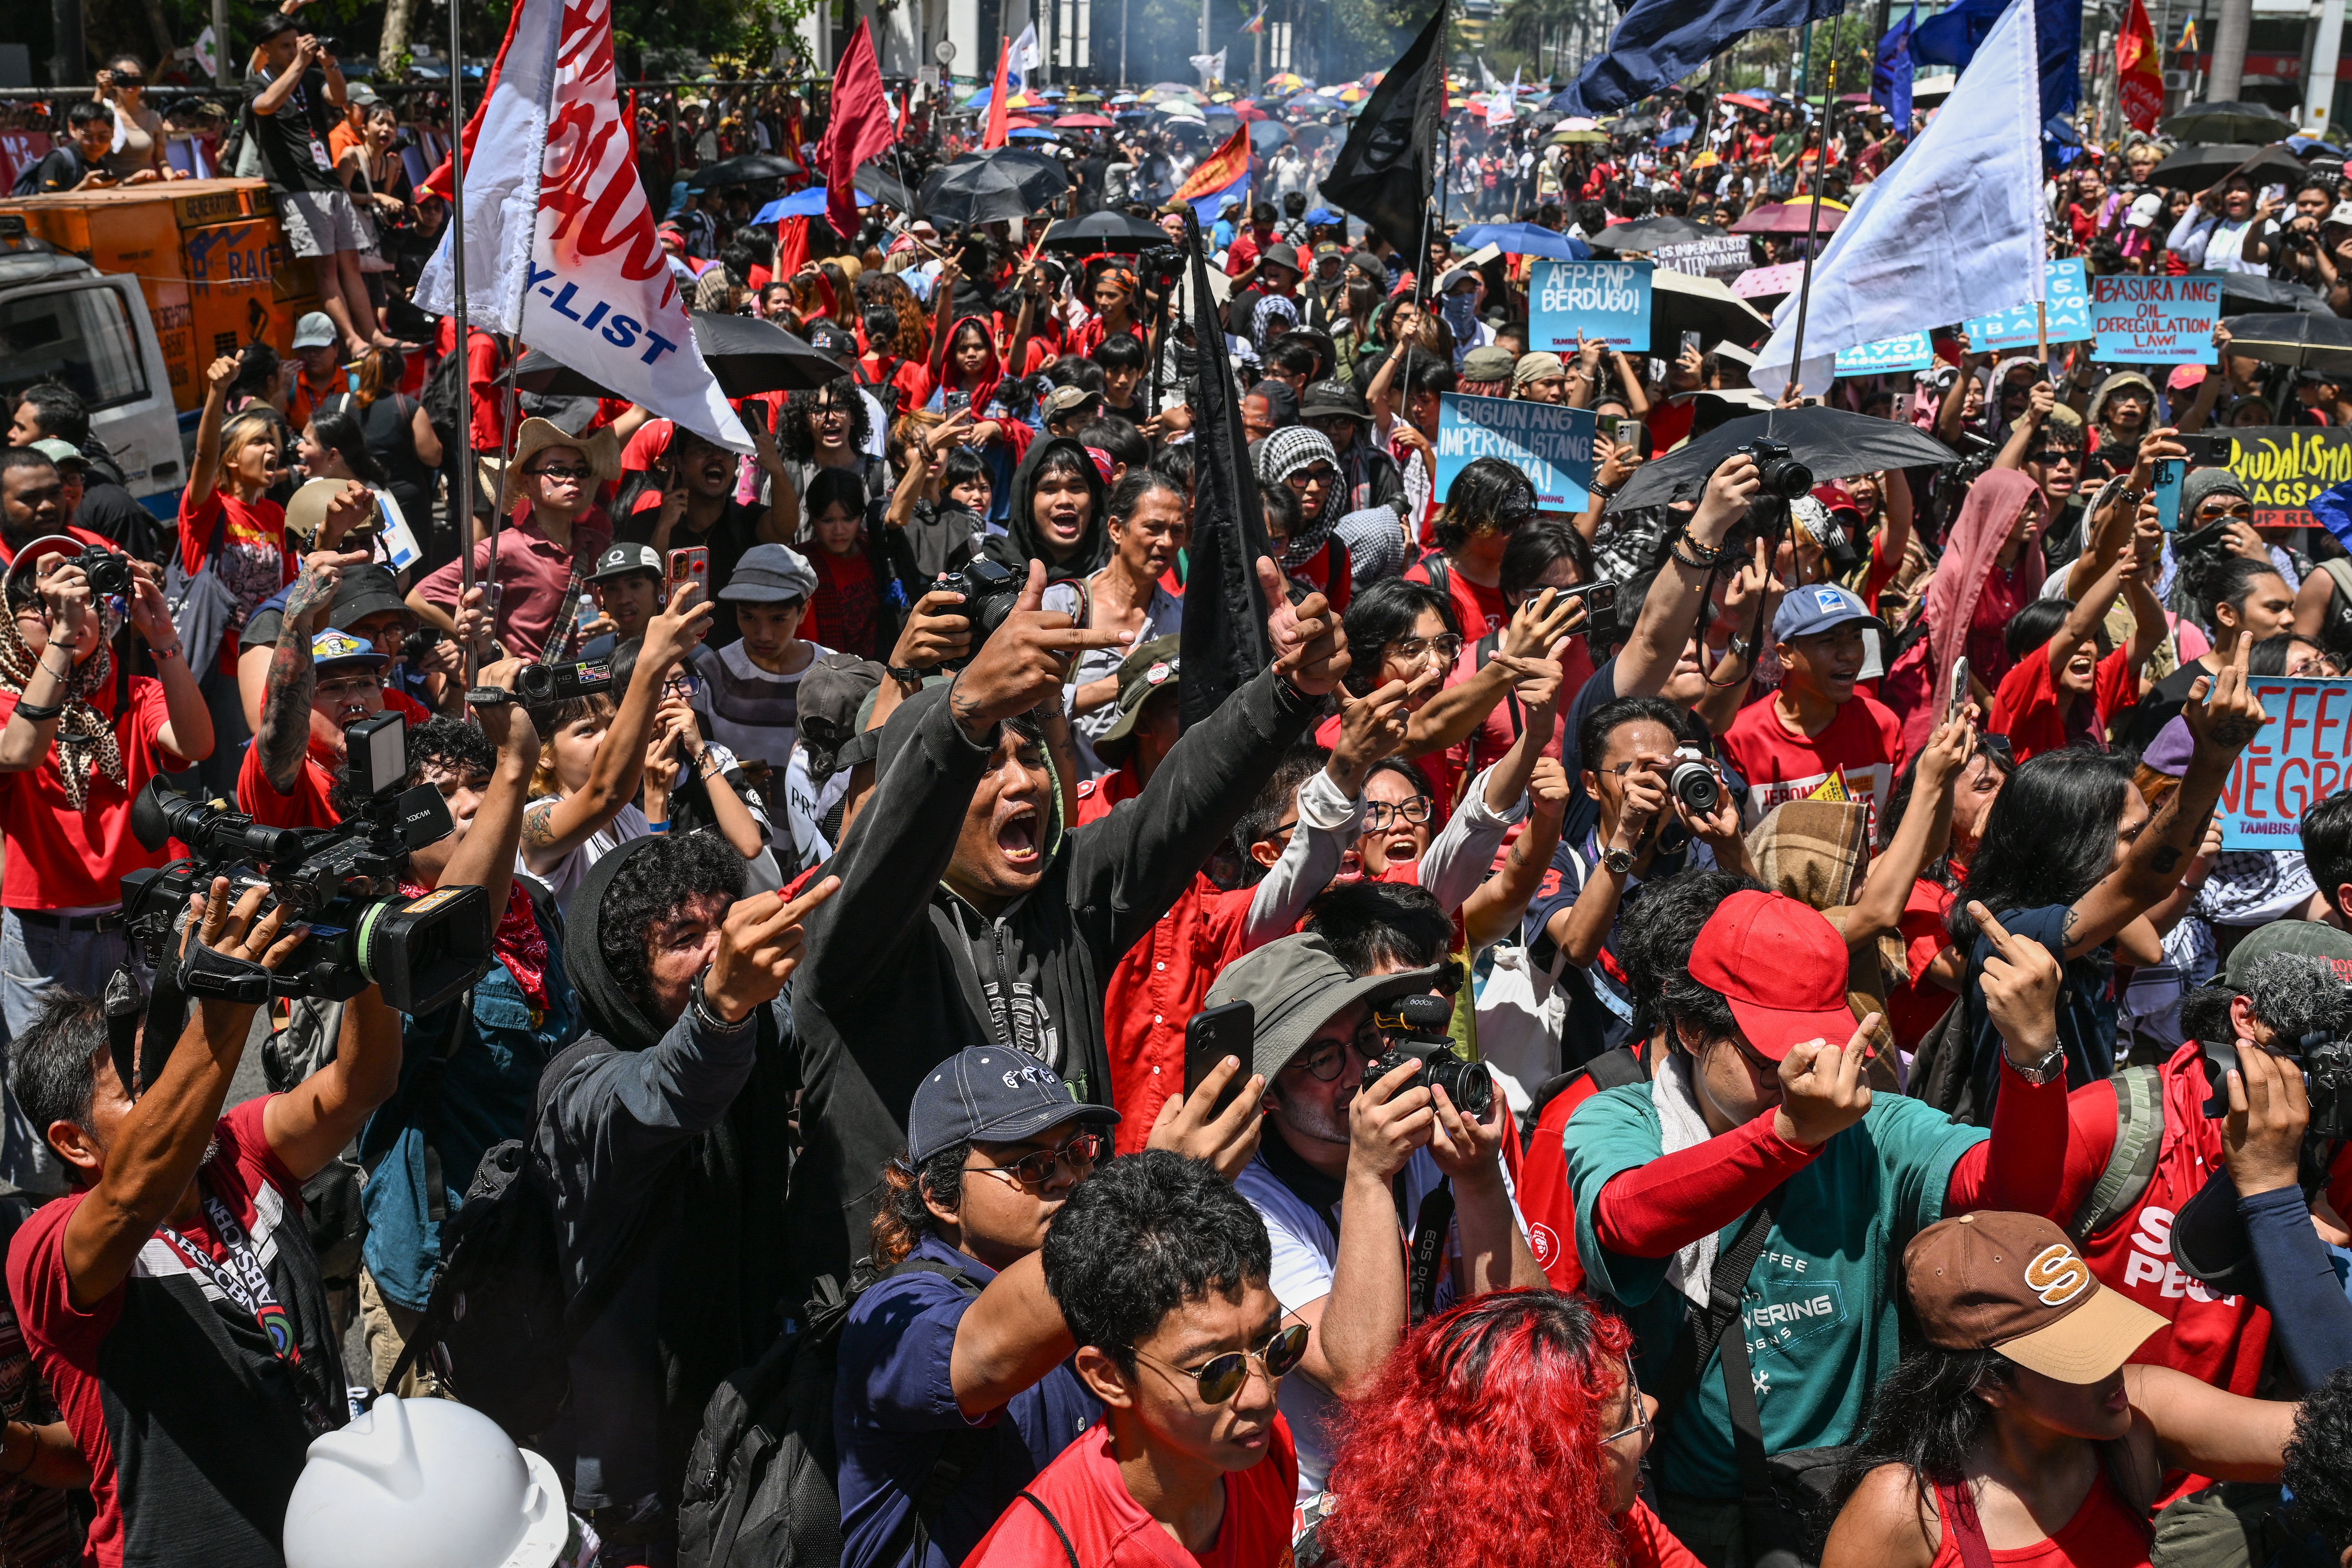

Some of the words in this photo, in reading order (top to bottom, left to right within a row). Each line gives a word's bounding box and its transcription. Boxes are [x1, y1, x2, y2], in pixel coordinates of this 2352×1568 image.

[1546, 264, 1634, 291] AFP-PNP
[2094, 278, 2174, 303] IBASURA
[2180, 281, 2217, 302] ANG
[1541, 288, 1639, 315] BERDUGO!
[2136, 303, 2168, 318] OIL
[2097, 318, 2211, 333] DEREGULATION
[1456, 399, 1527, 429] BIGUIN
[1530, 406, 1573, 431] ANG
[1439, 427, 1589, 462] IMPERYALISTANG
[406, 809, 431, 823] XDCAM
[396, 851, 406, 859] SONY
[1443, 1040, 1455, 1049] Canon
[1421, 1230, 1437, 1261] EOS
[2024, 1243, 2090, 1307] S
